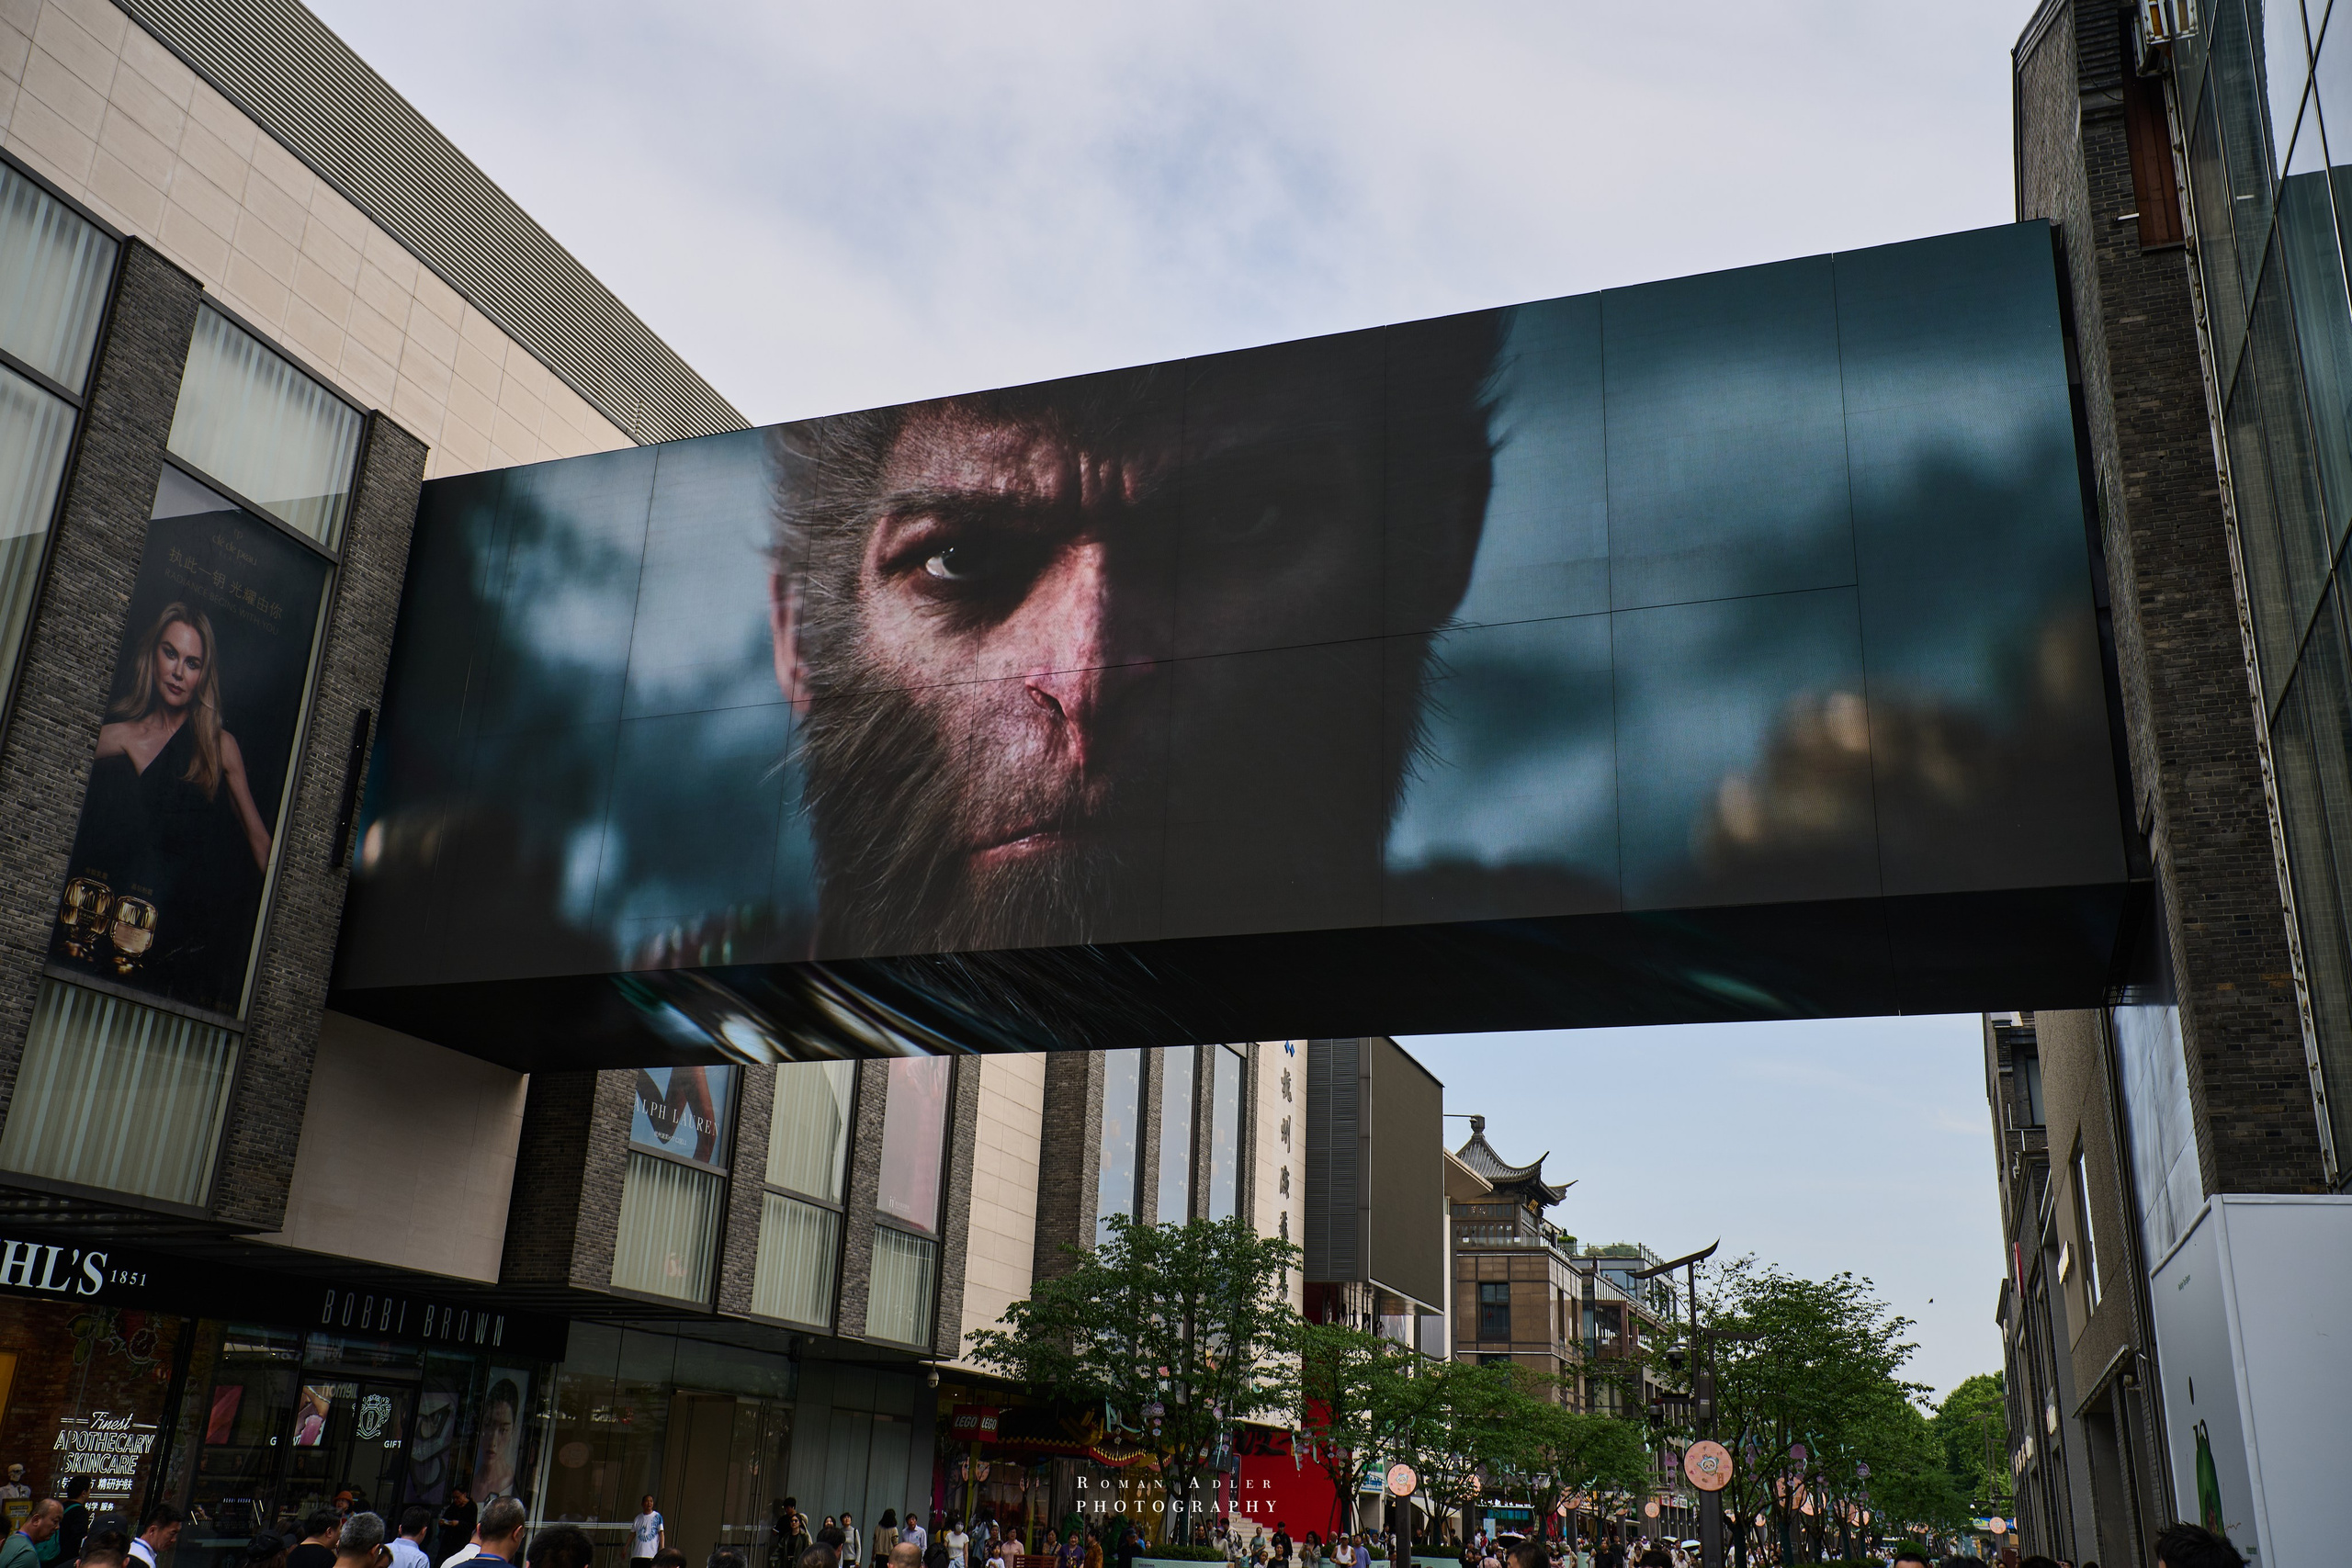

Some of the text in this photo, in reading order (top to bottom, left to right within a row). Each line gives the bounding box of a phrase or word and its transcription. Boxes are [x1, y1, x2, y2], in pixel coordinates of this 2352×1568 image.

[225, 541, 237, 554] de
[236, 549, 257, 566] peau
[169, 546, 283, 619] 执此一钥 光耀由你
[164, 568, 279, 637] RADIANCE BEGINS WITH YOU
[634, 1097, 720, 1137] ALPH LAUREN
[0, 1239, 147, 1296] HL'S 1851
[322, 1288, 505, 1348] BOBBI BROWN
[90, 1411, 134, 1431] Finest
[954, 1415, 998, 1430] LEGO LEGO
[52, 1429, 156, 1454] APOTHECARY
[383, 1439, 402, 1450] GIFT
[61, 1451, 140, 1475] SKINCARE
[96, 1477, 133, 1491] 精研护肤
